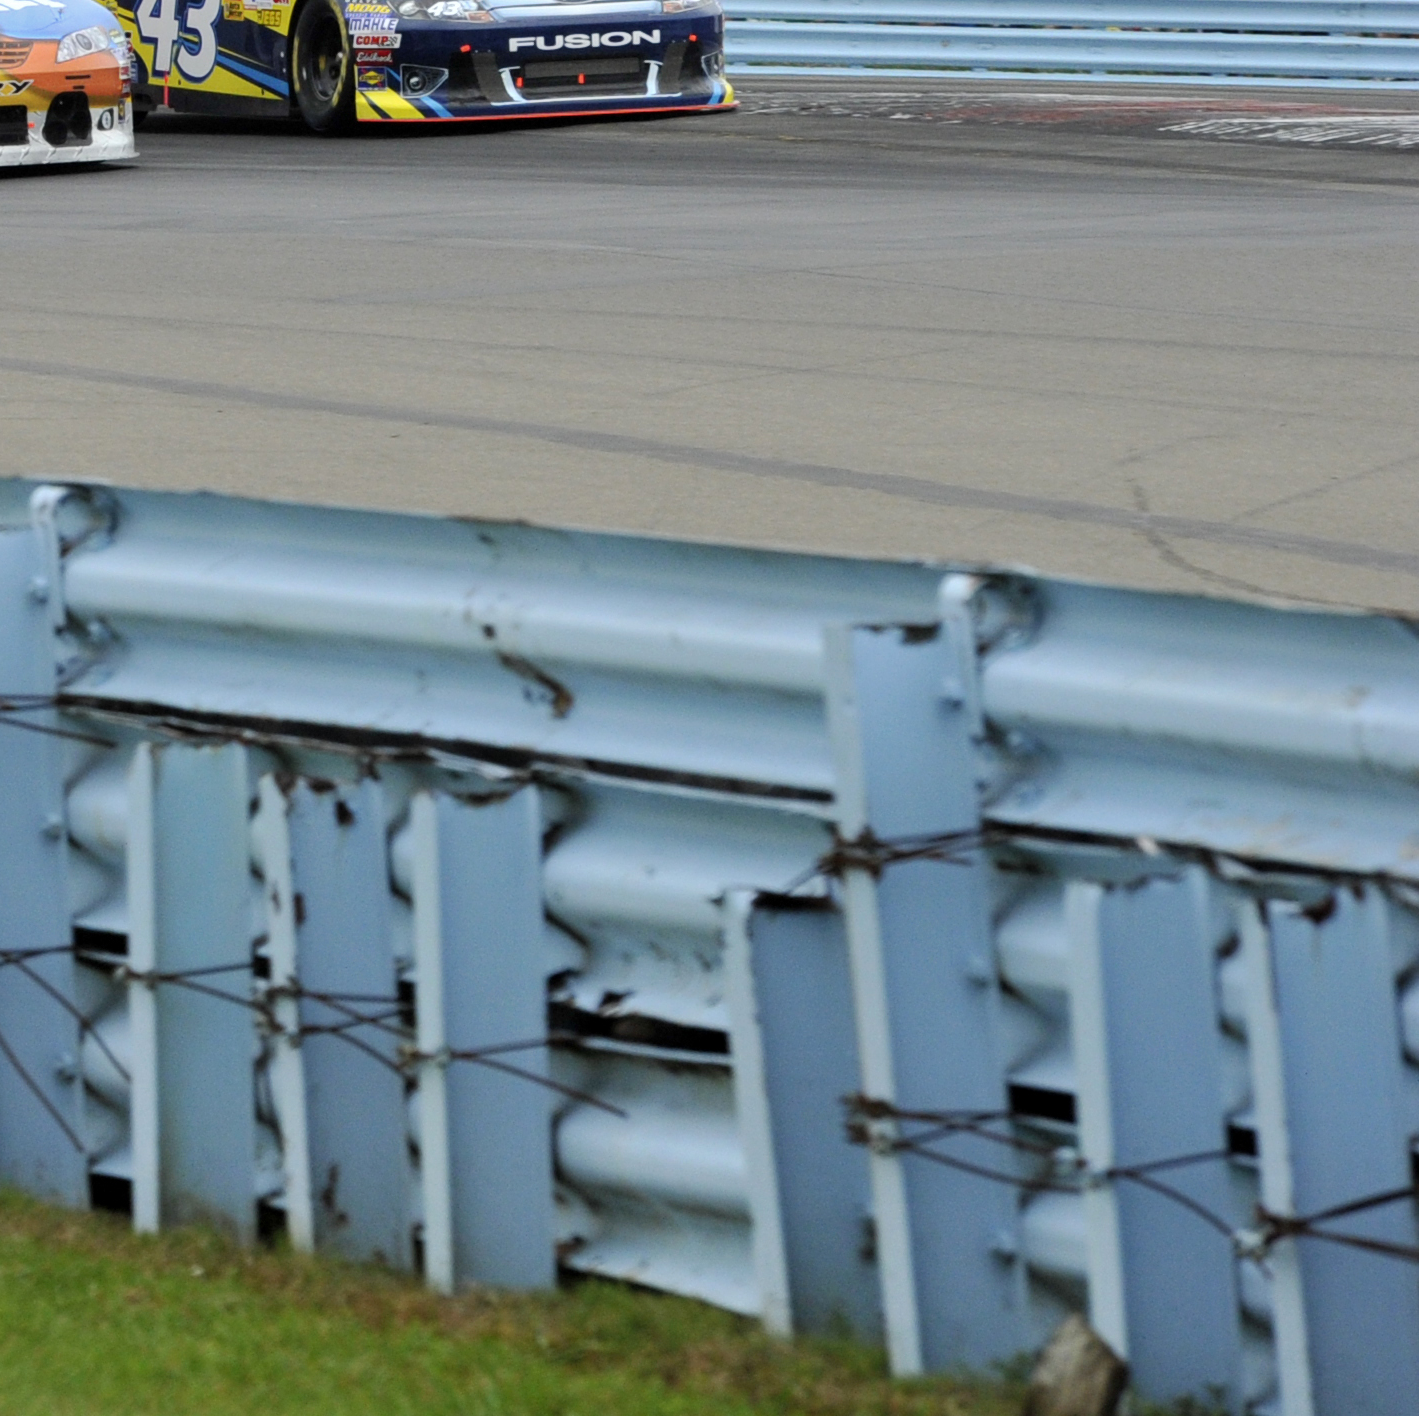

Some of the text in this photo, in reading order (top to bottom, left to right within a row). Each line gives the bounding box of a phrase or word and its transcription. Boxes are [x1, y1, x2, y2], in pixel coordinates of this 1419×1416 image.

[347, 3, 390, 14] MOOG
[428, 0, 460, 17] 43
[257, 9, 281, 26] JEGS
[350, 18, 397, 31] MAHLE
[356, 36, 389, 45] COMP
[509, 30, 661, 52] FUSION
